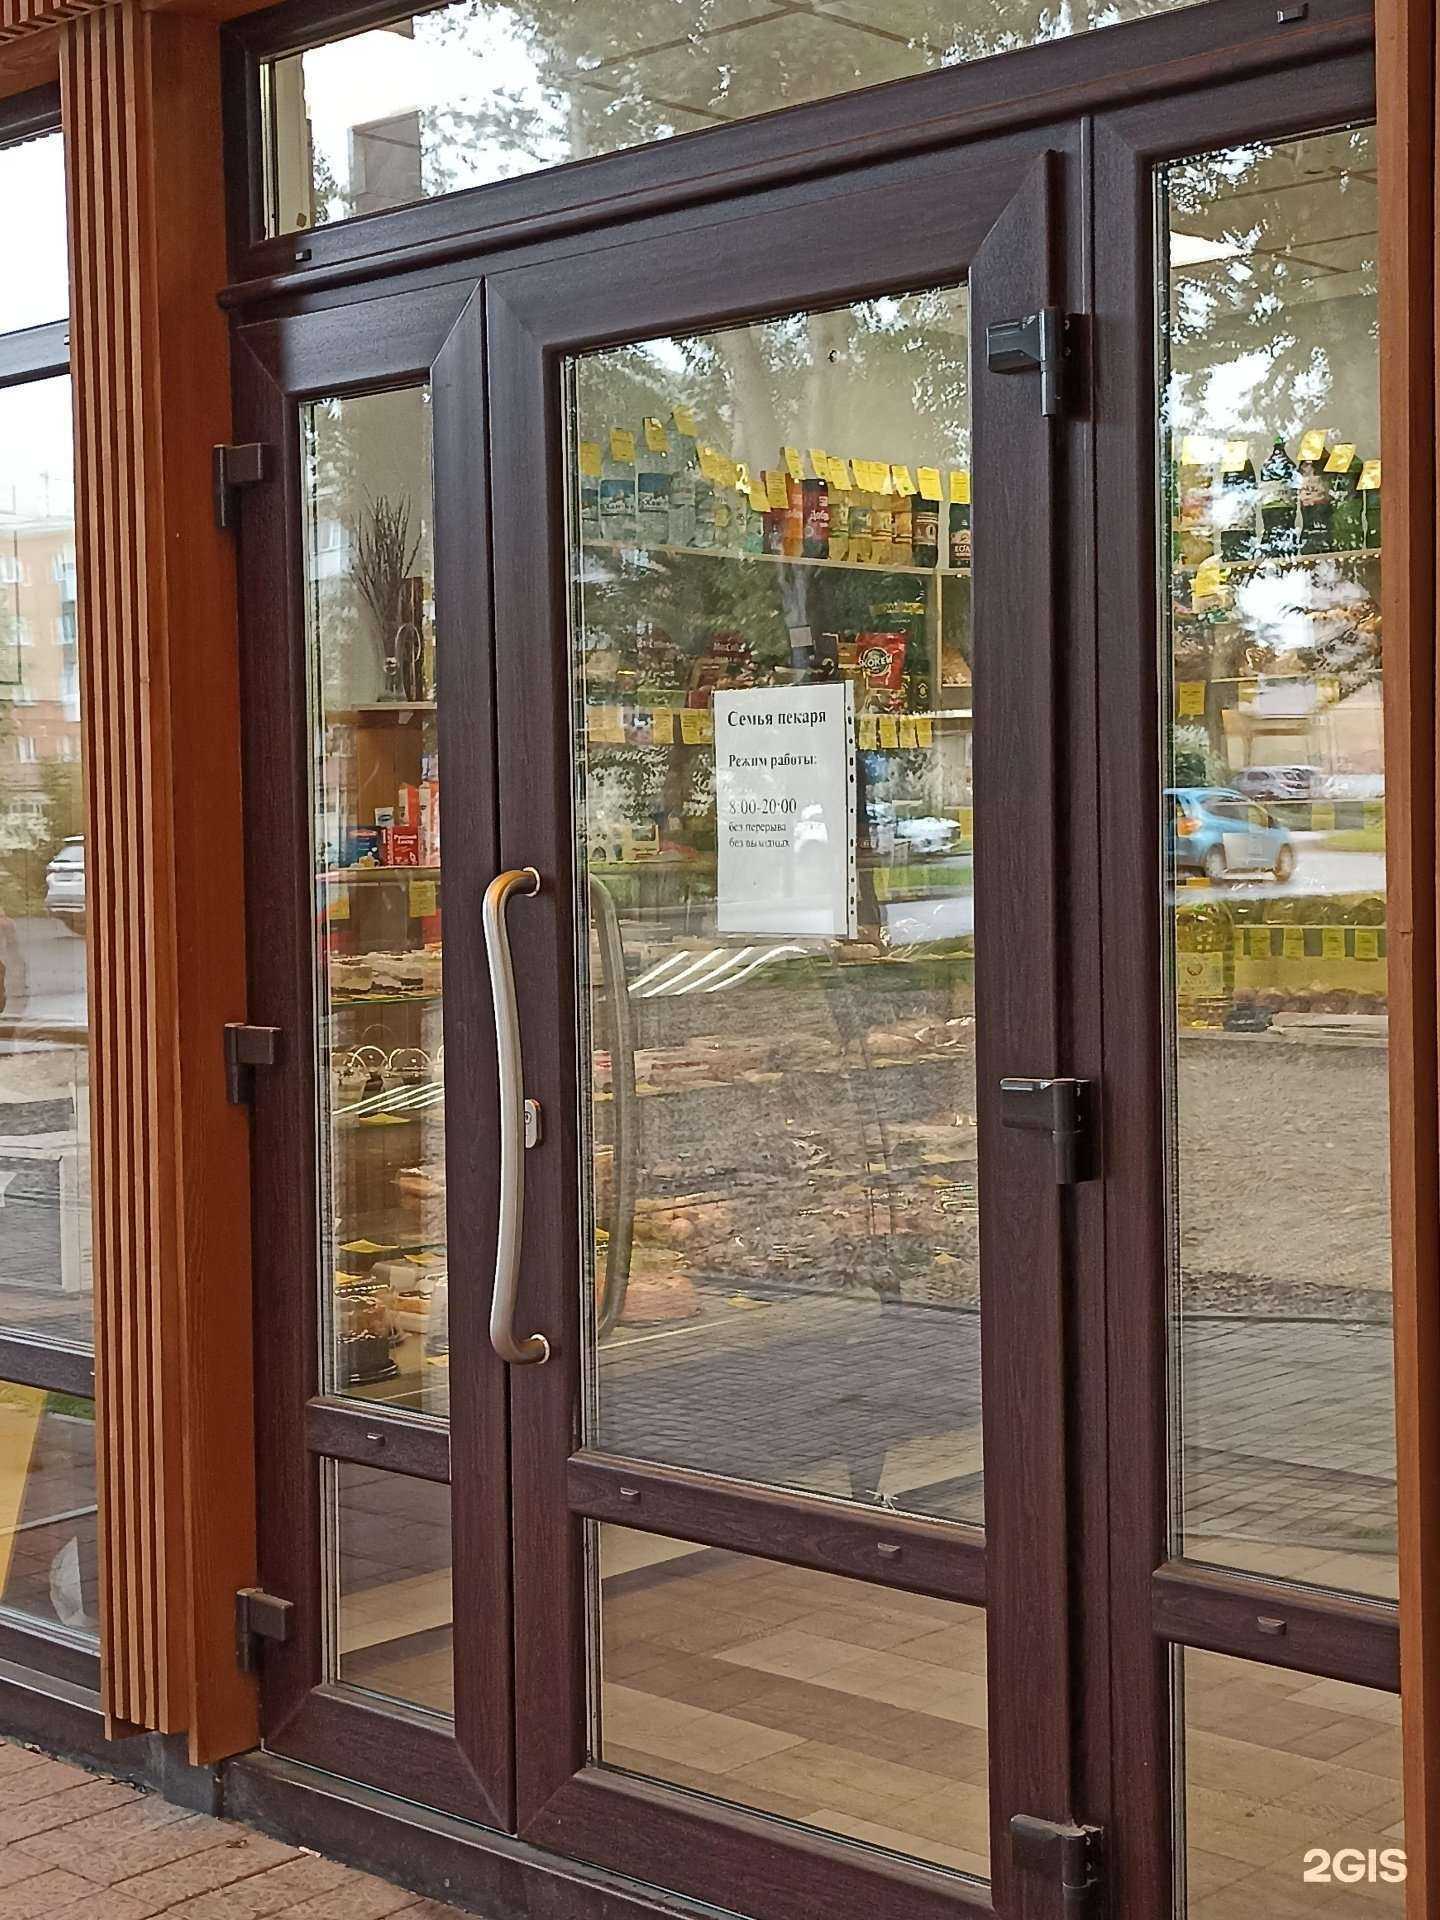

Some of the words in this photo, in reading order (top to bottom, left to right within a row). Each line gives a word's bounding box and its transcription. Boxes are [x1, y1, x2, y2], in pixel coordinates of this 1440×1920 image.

[727, 710, 773, 727] Семья
[778, 711, 826, 727] пекаря
[728, 754, 767, 768] Режим
[770, 753, 817, 769] работы:
[728, 821, 743, 832] без
[745, 823, 787, 834] перерыва
[728, 837, 743, 848] без
